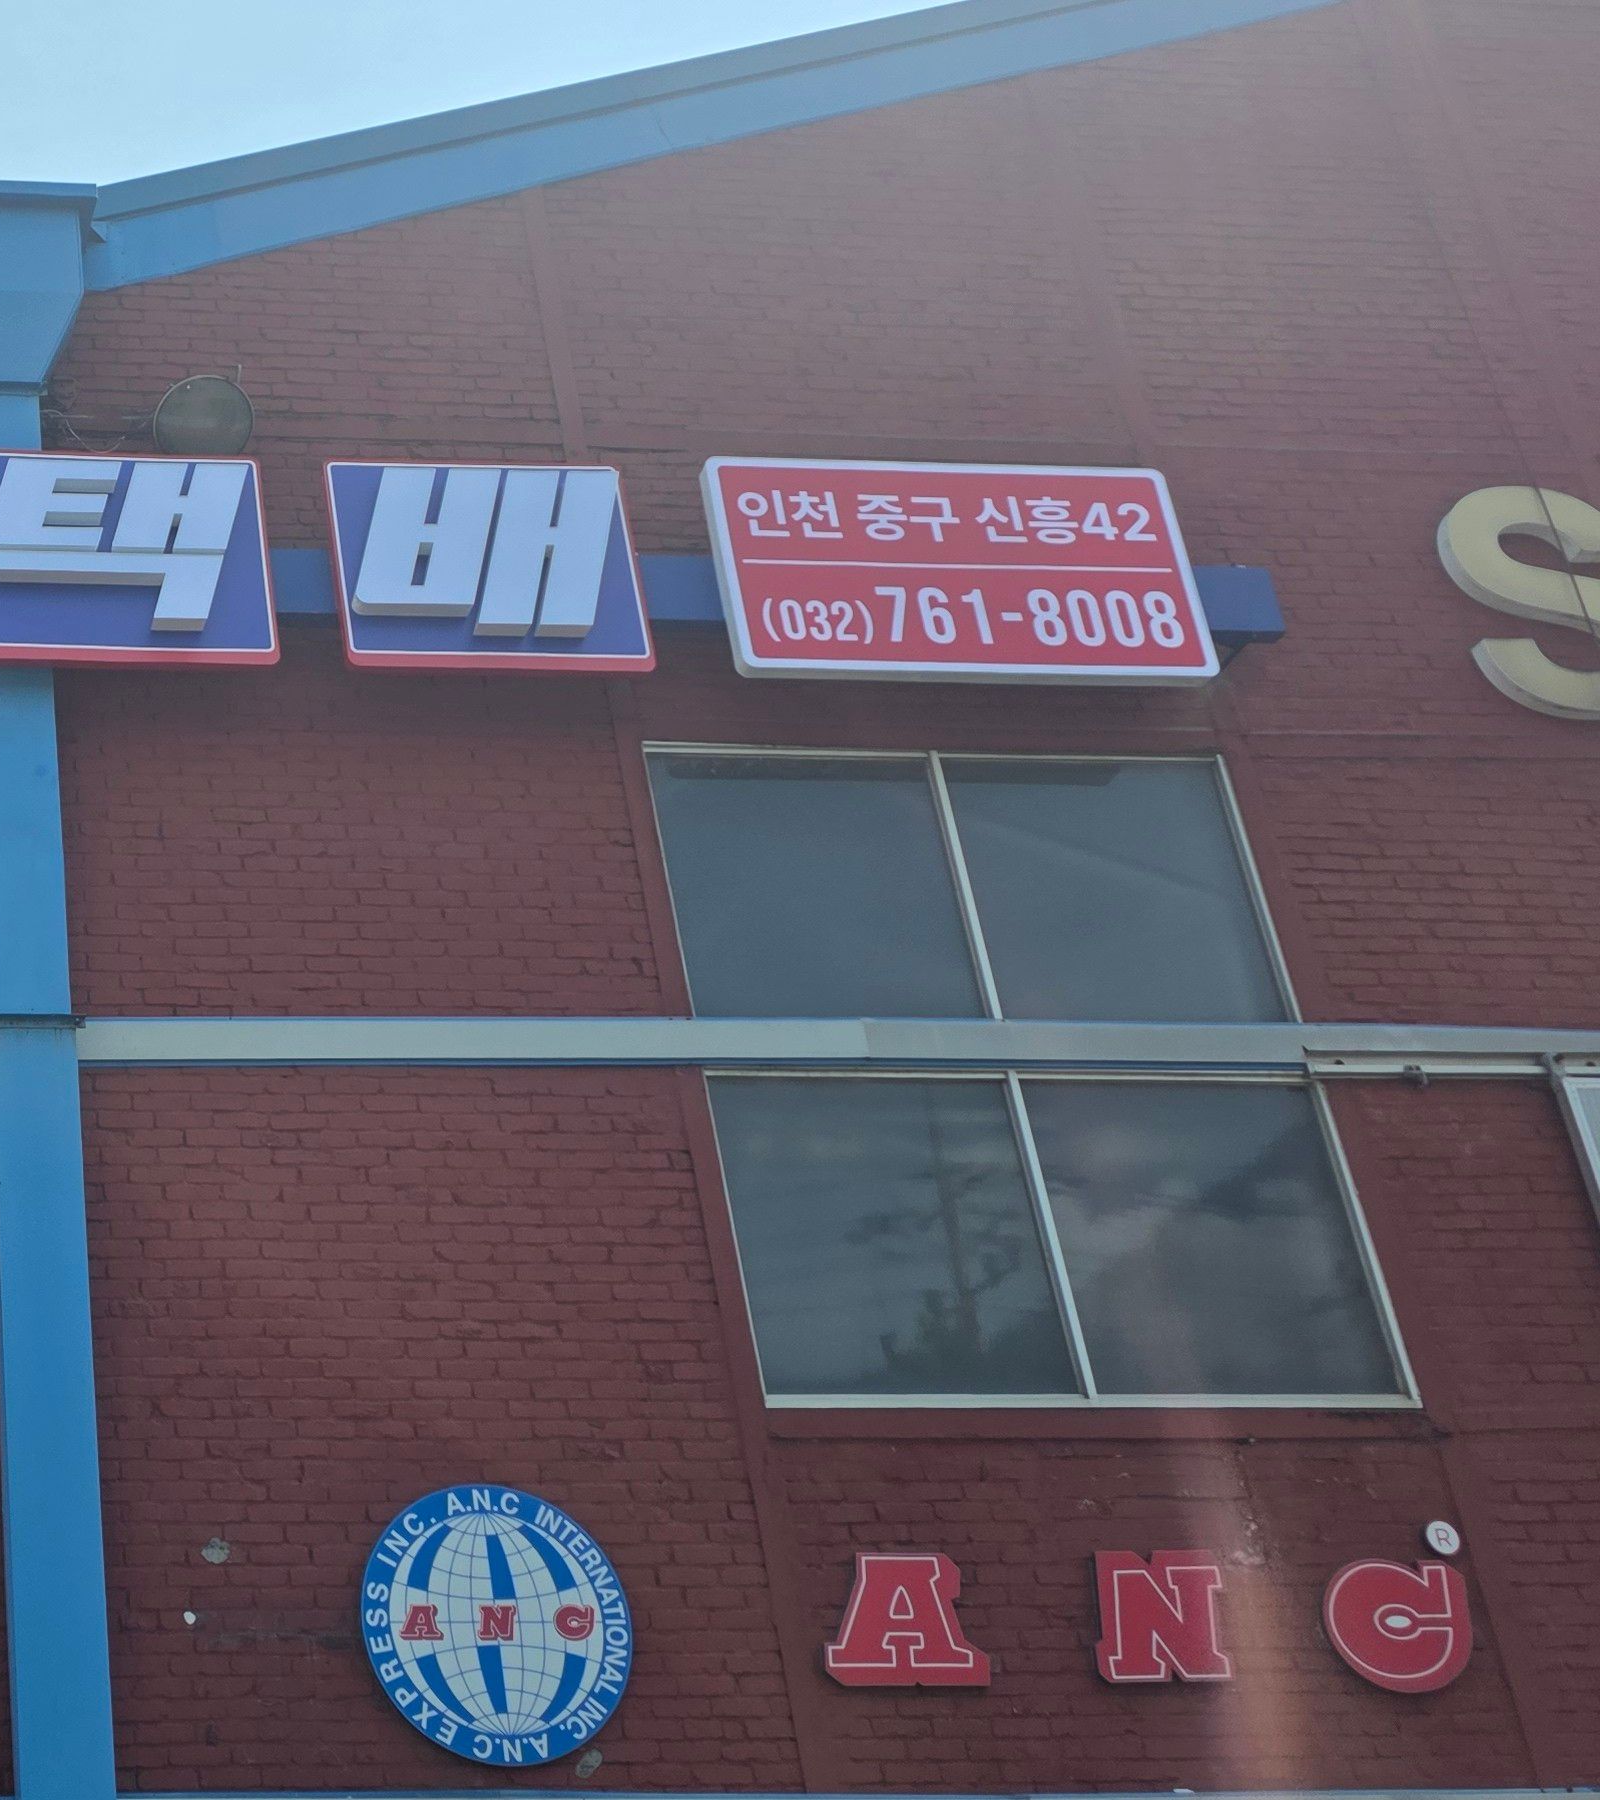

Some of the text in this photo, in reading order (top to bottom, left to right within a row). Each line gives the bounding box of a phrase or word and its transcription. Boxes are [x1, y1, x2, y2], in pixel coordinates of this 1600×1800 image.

[737, 490, 1157, 545] 인천 중구 신흥42
[377, 1513, 437, 1568] INC.
[366, 1581, 458, 1746] EXPRESS
[447, 1489, 628, 1740] A.N.C INTERNATIONAL INC.
